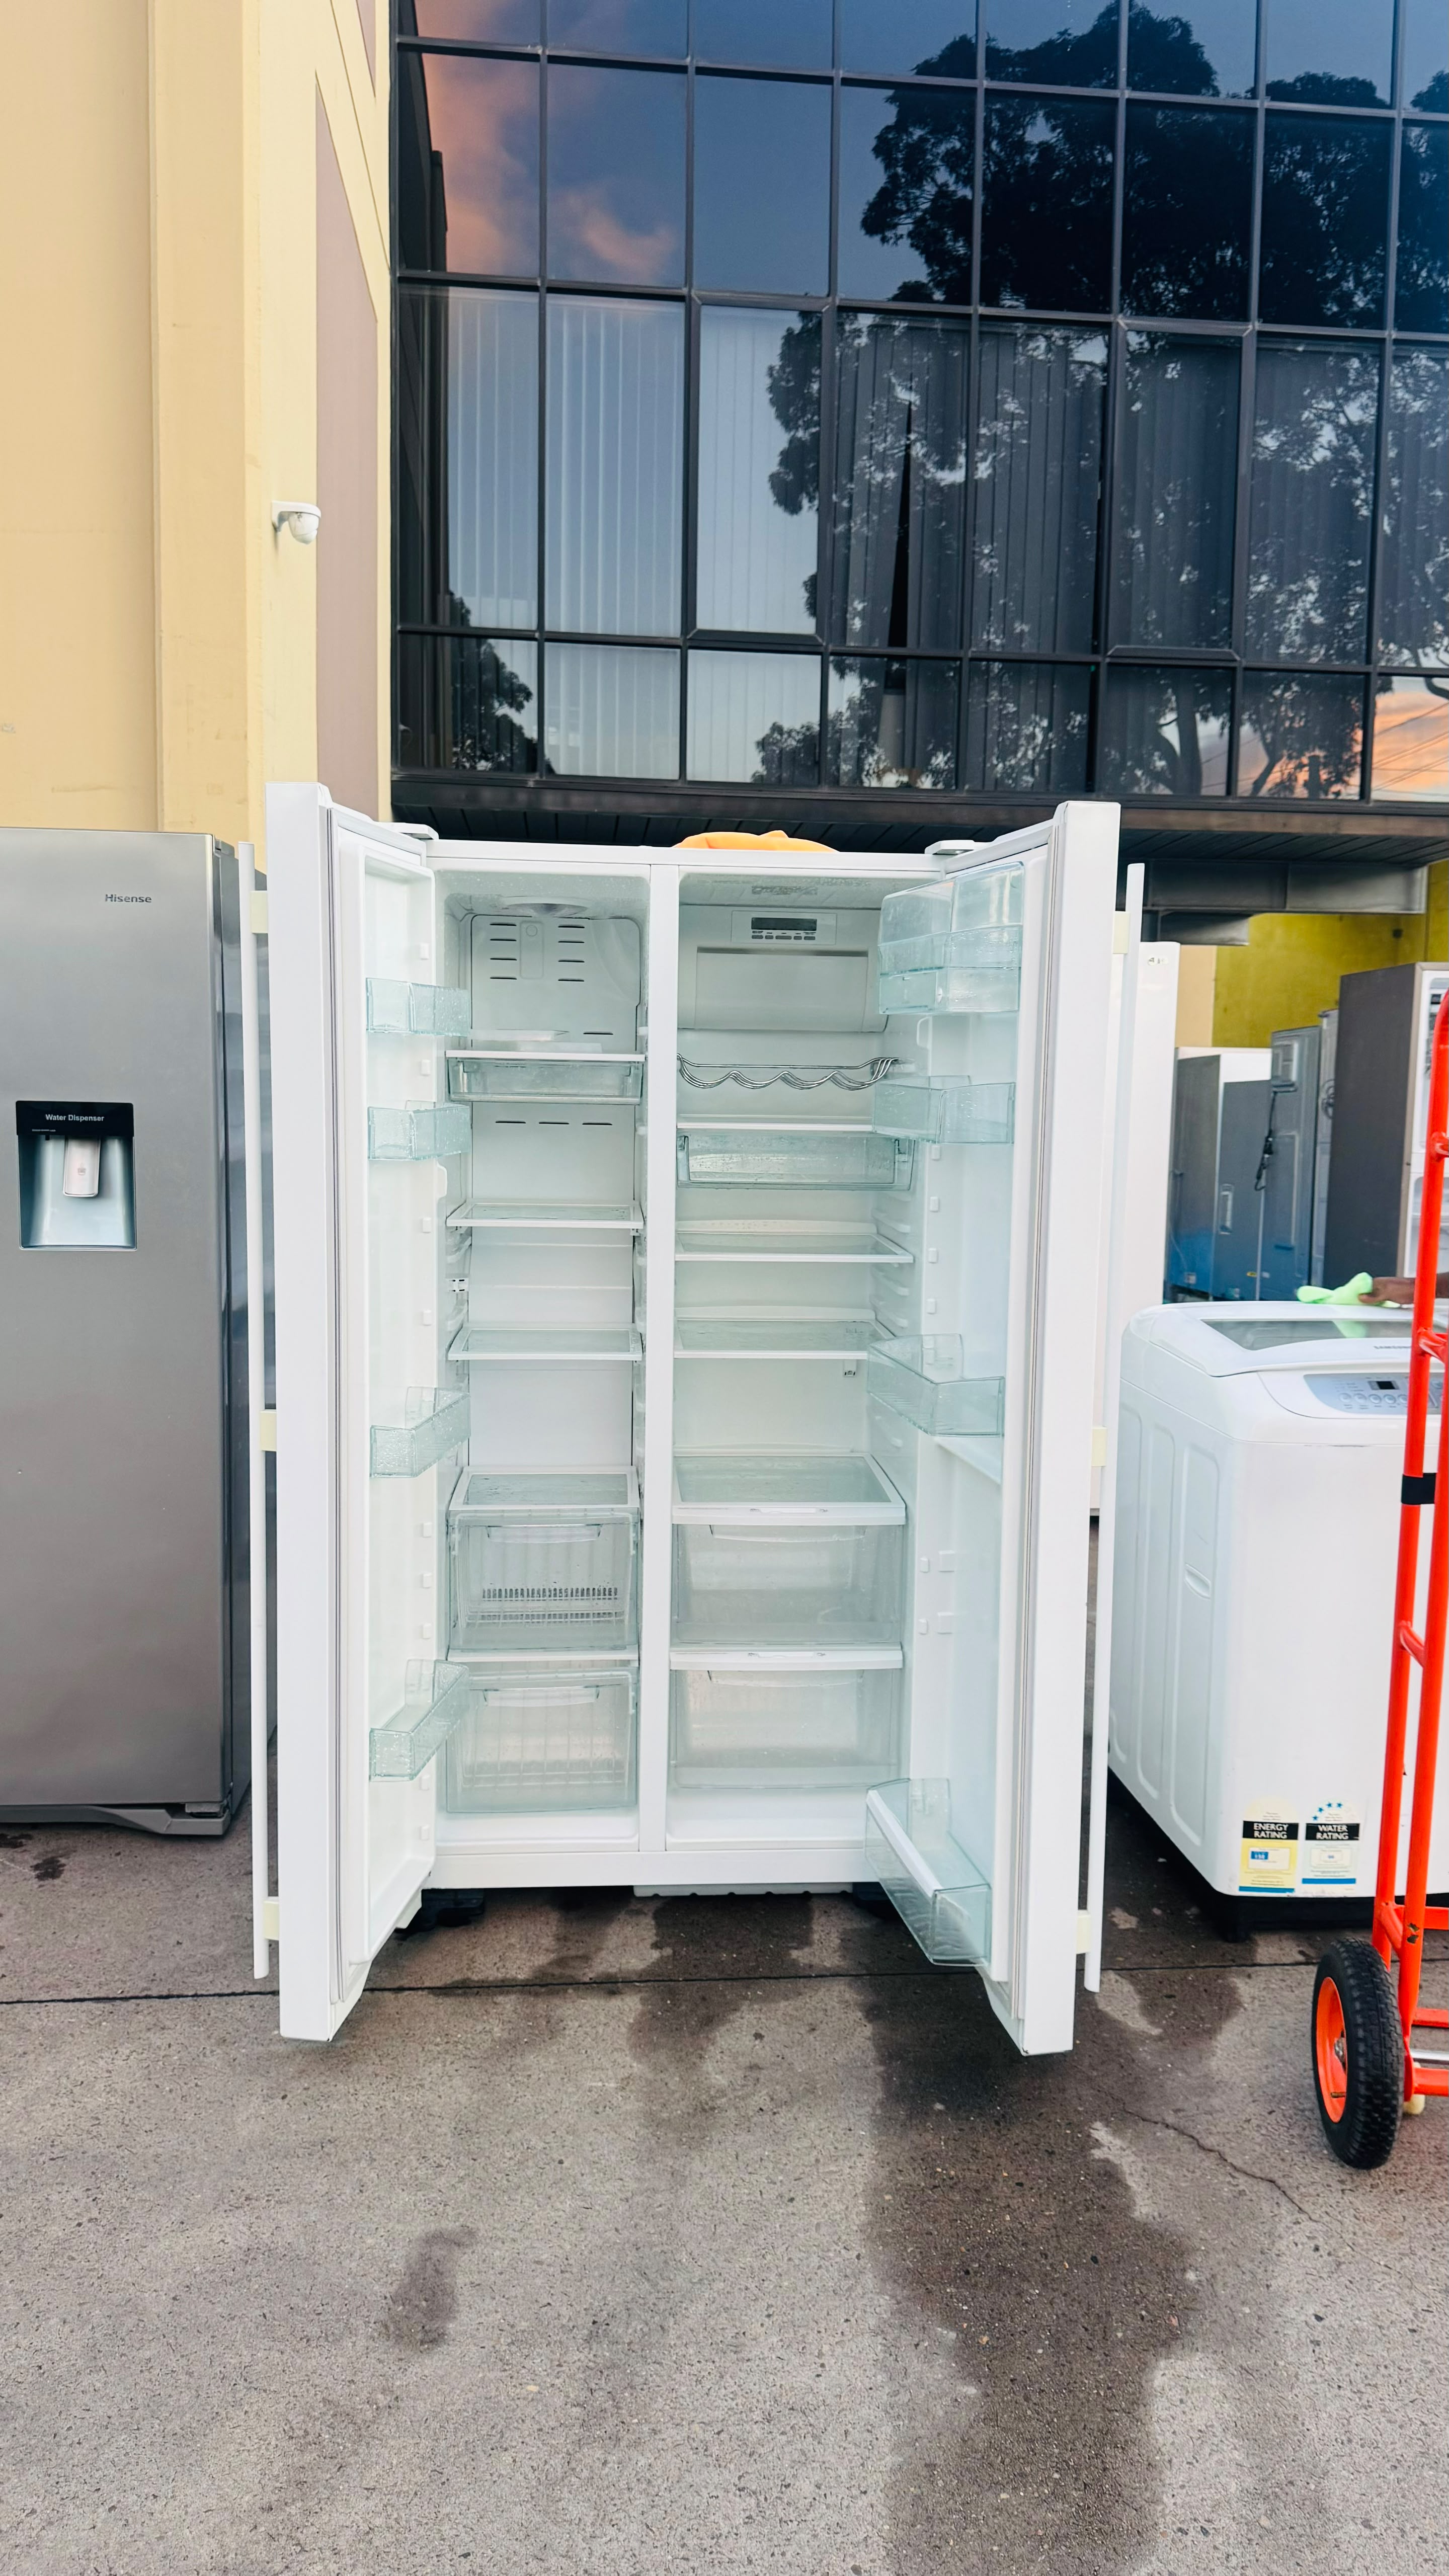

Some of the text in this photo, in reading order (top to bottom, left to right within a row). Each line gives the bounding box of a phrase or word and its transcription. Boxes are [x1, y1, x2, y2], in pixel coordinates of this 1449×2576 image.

[105, 894, 152, 903] Hisense
[1253, 1823, 1289, 1831] ENERGY
[1254, 1830, 1287, 1839] RATING
